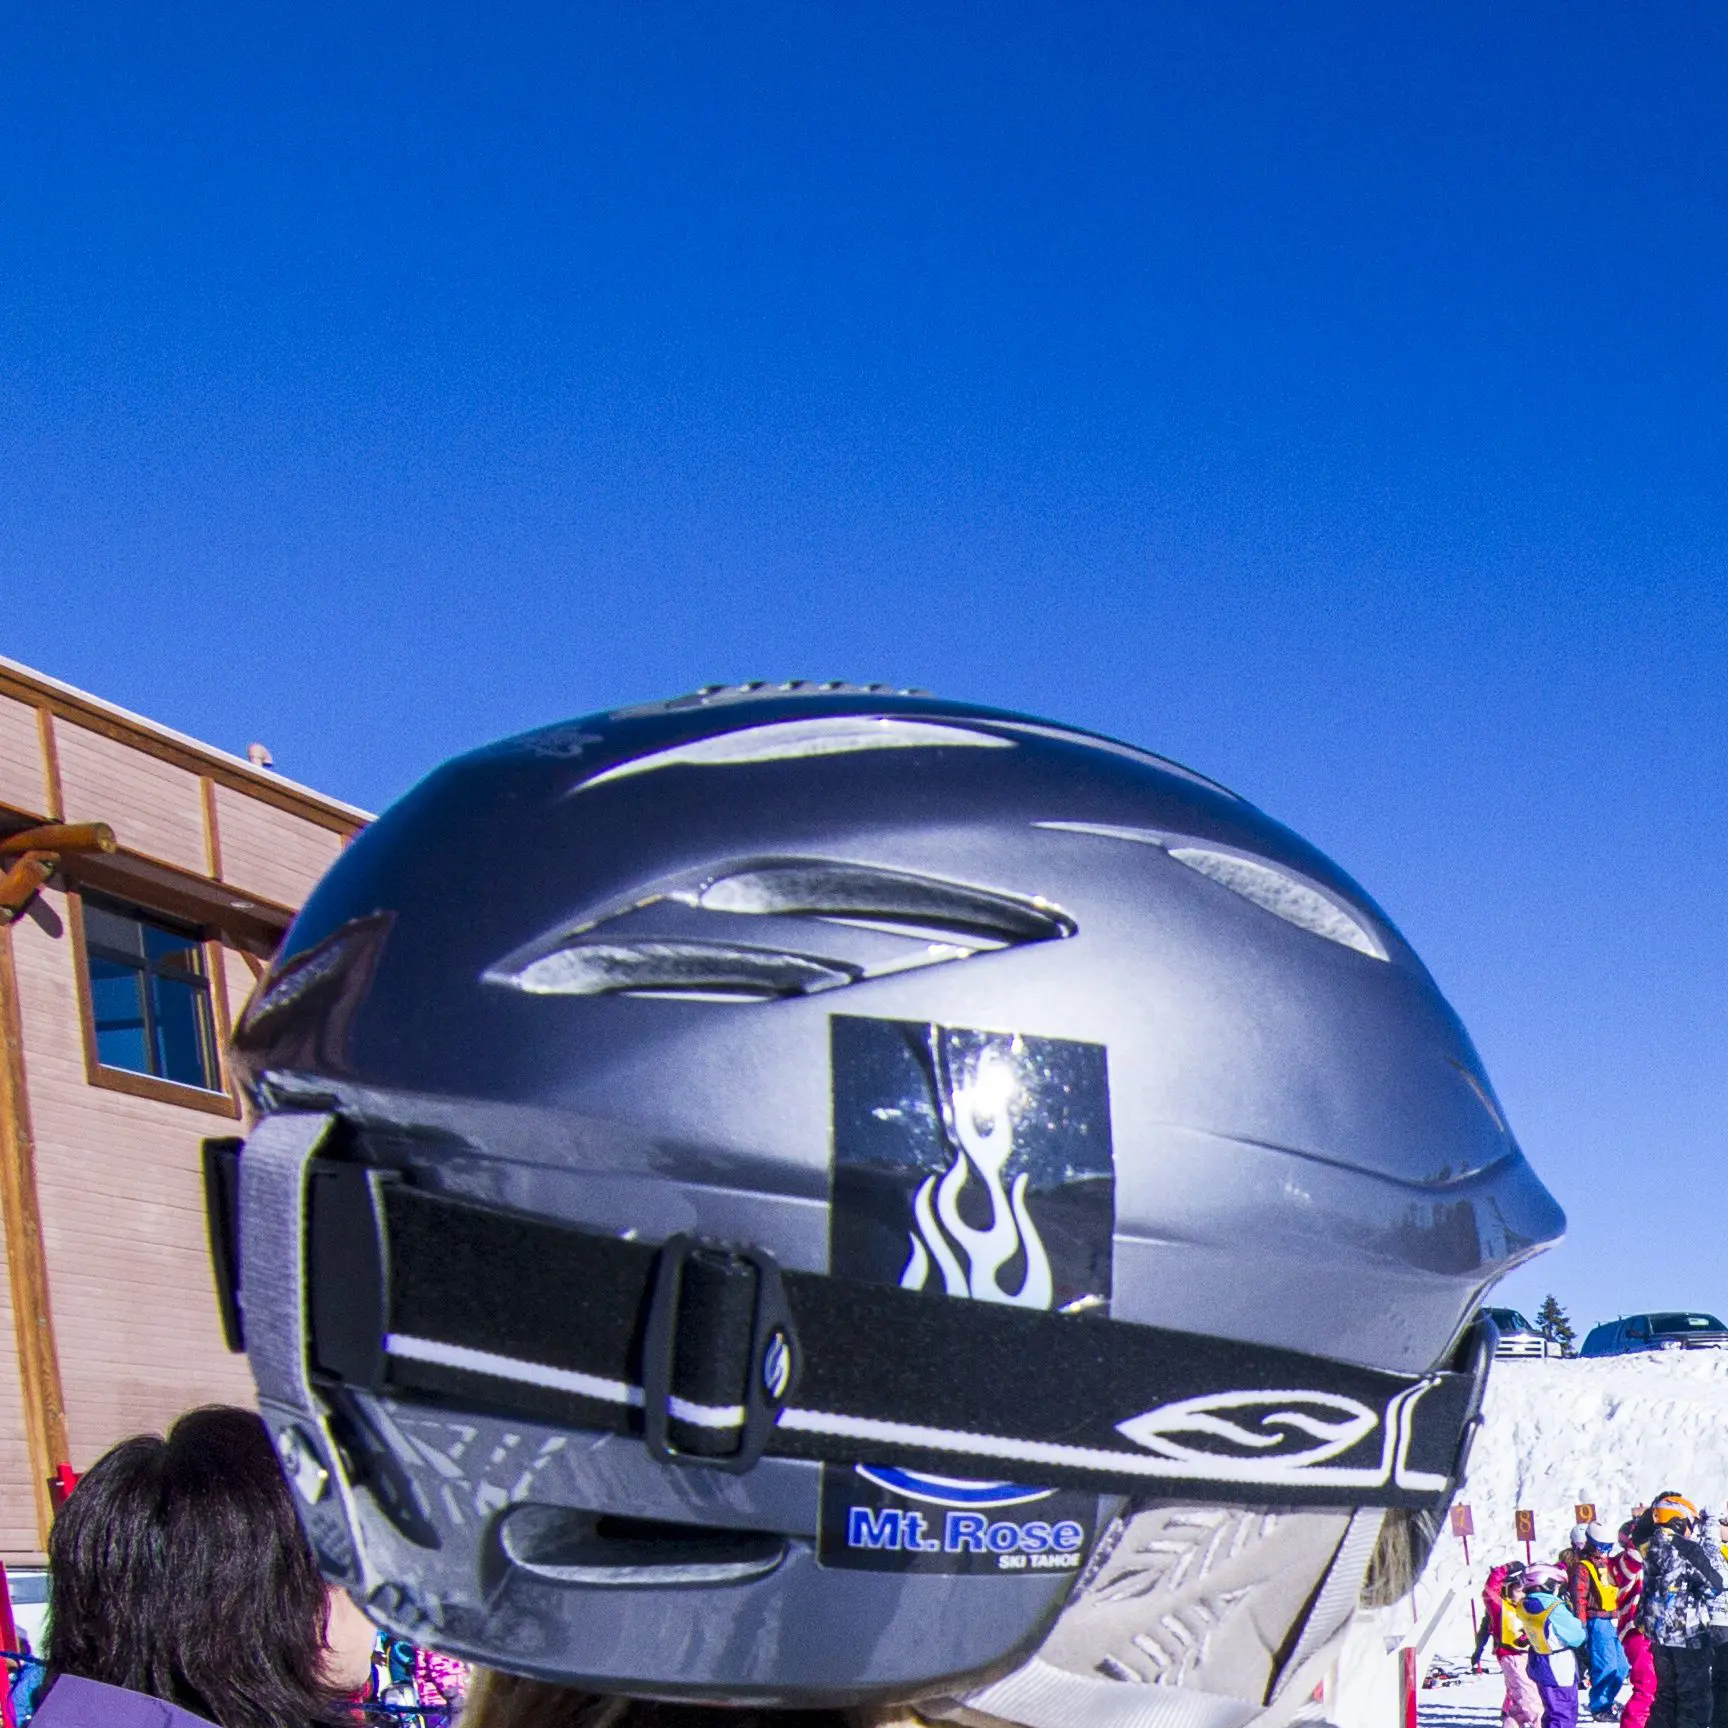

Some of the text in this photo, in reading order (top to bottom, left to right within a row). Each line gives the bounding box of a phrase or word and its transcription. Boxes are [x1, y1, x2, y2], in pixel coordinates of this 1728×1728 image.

[1457, 1508, 1467, 1529] 7
[1580, 1504, 1594, 1522] 9
[848, 1506, 1084, 1553] Mt. Rose
[1519, 1514, 1531, 1533] 8
[997, 1553, 1026, 1569] SKI
